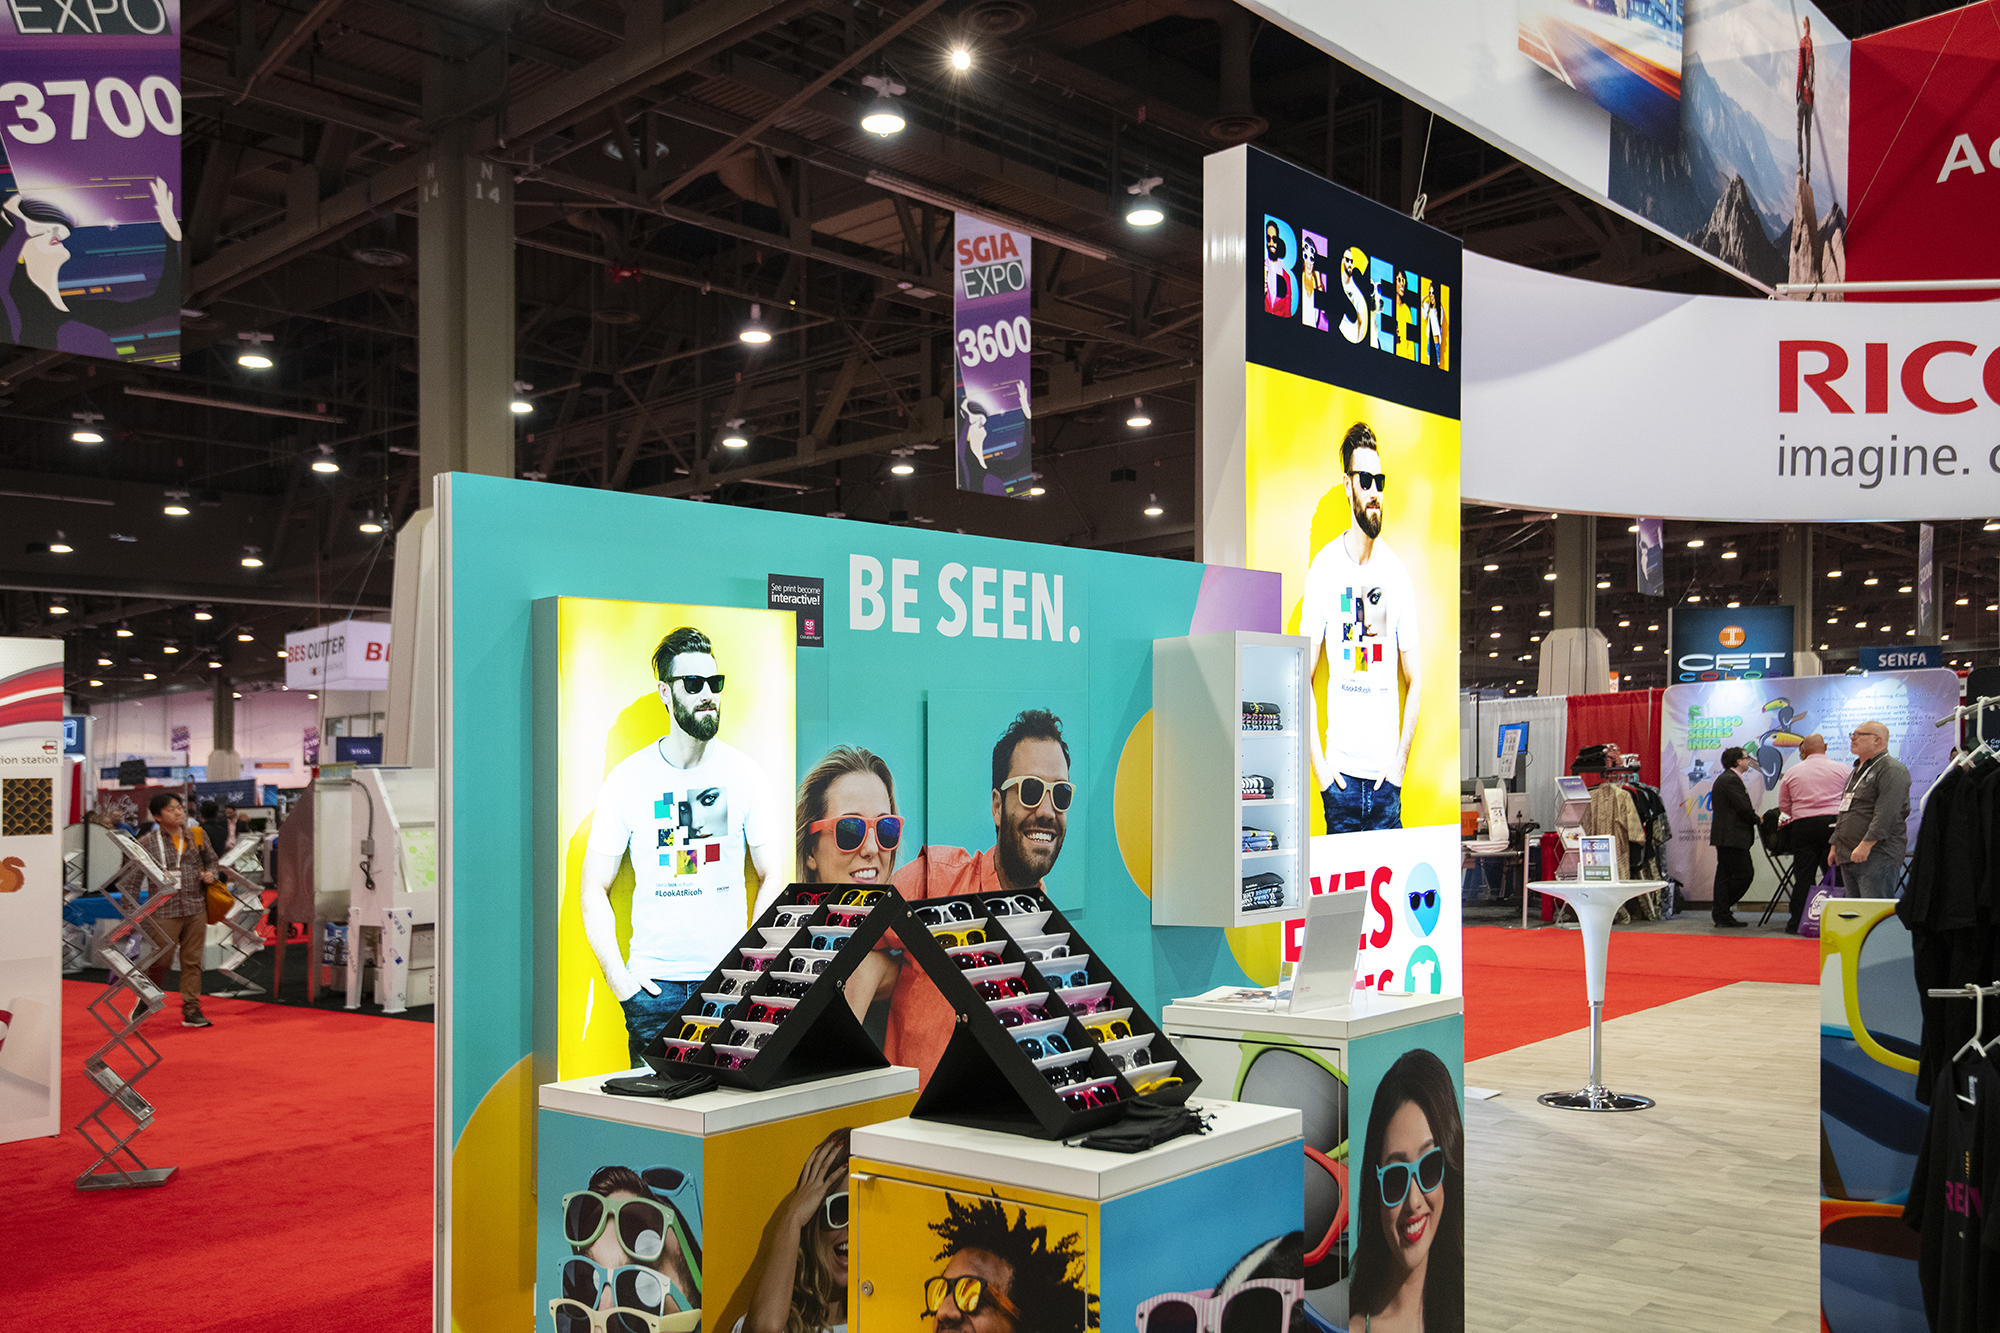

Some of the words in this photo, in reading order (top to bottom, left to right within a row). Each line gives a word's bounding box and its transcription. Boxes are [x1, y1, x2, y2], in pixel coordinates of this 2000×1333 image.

[4, 0, 166, 35] EXPO
[0, 74, 182, 145] 3700
[957, 232, 1020, 266] SGIA
[961, 261, 1026, 300] EXPO
[1264, 213, 1329, 332] BE
[1338, 246, 1450, 372] SEEN
[958, 315, 1031, 367] 3600
[1778, 339, 2000, 416] RIC
[1778, 433, 1970, 490] imagine.
[771, 583, 782, 592] See
[783, 585, 797, 594] print
[797, 585, 821, 595] become
[771, 591, 820, 605] interactive!
[850, 553, 921, 634] BE
[936, 562, 1081, 644] SEEN.
[287, 644, 306, 664] BES
[307, 636, 345, 660] CUTTER
[365, 642, 390, 662] B
[1677, 652, 1786, 672] CET
[1878, 652, 1927, 667] SENFA
[1687, 727, 1733, 739] SERIES
[1715, 716, 1743, 727] ECO
[1687, 738, 1722, 751] INKS
[22, 755, 59, 766] station
